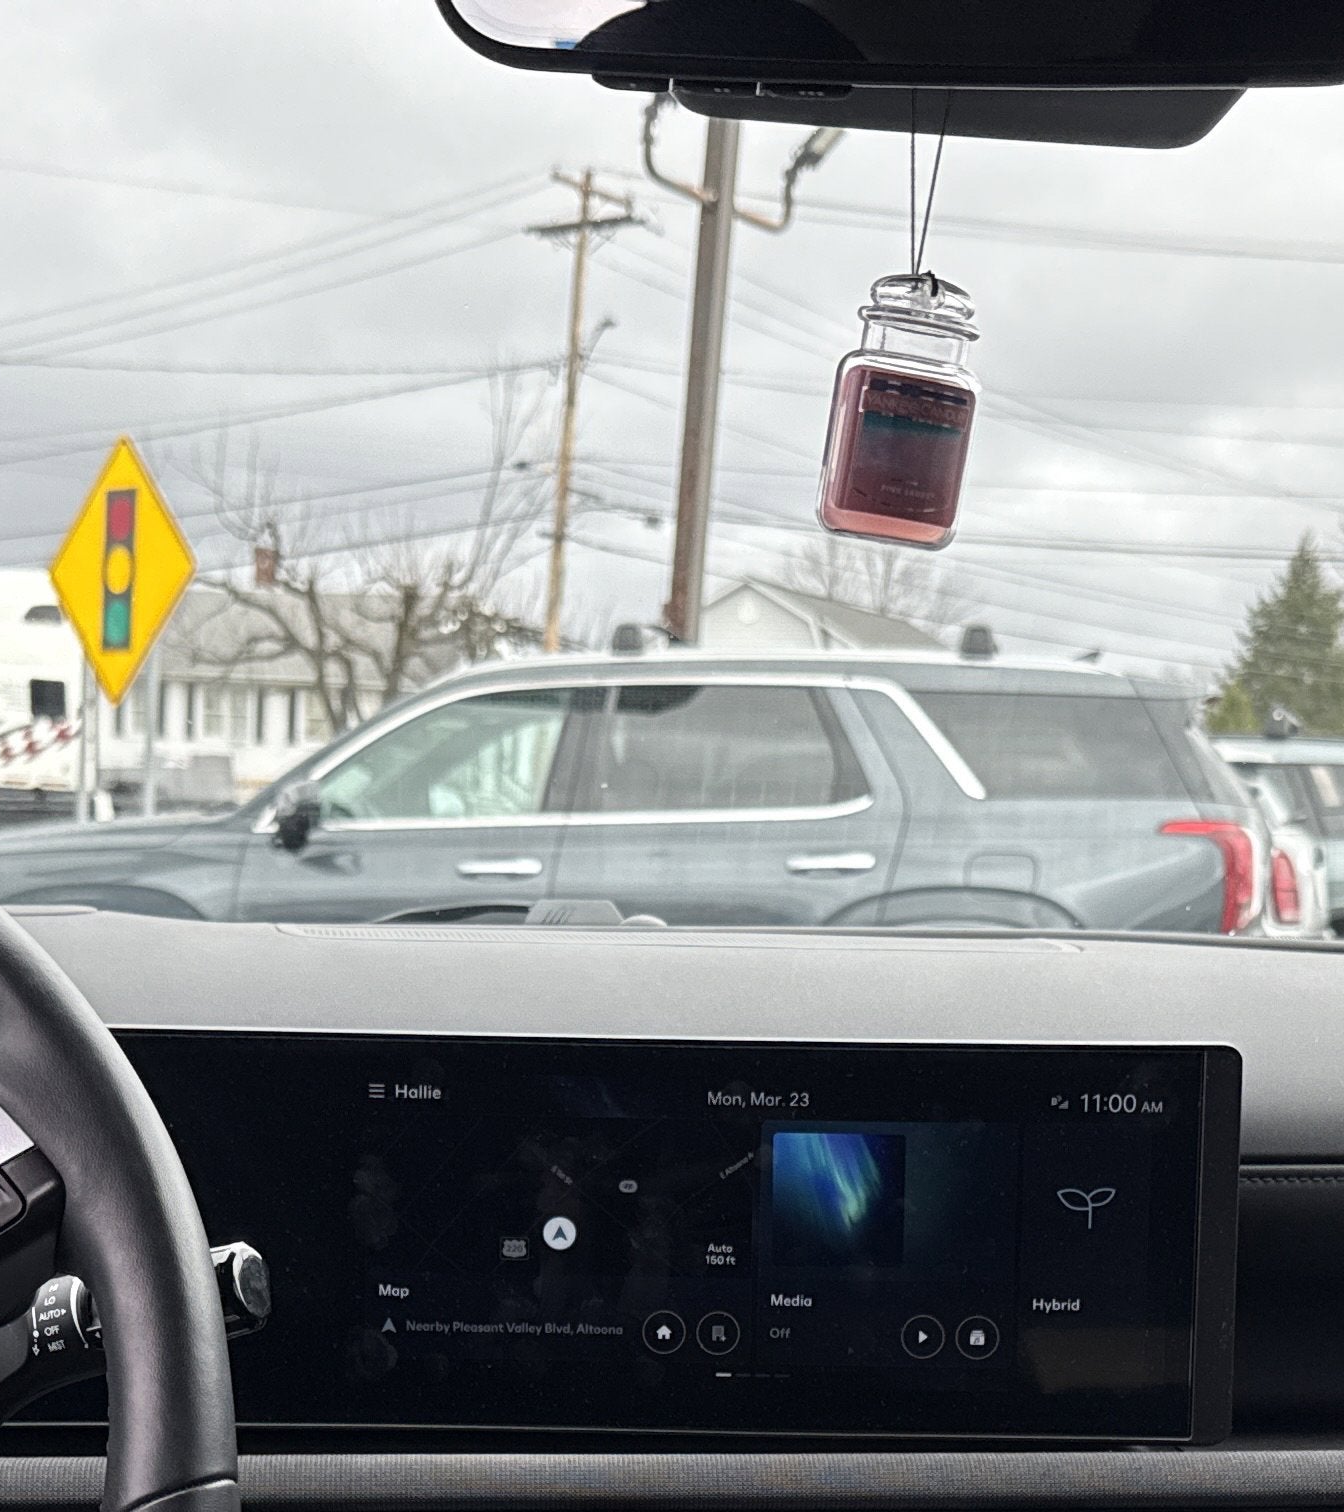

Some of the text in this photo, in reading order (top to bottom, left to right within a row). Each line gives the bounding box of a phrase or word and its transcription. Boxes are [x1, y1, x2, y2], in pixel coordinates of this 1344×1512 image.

[395, 1084, 442, 1100] Hallie
[707, 1092, 810, 1108] Mon, Mar. 23
[1080, 1094, 1163, 1113] 11:00 AM
[707, 1243, 733, 1254] Auto
[725, 1255, 736, 1266] ft
[378, 1284, 409, 1299] Map
[44, 1296, 56, 1306] LO
[770, 1294, 812, 1308] Media
[1032, 1298, 1080, 1314] Hybrid
[38, 1308, 61, 1322] AUTO
[44, 1325, 59, 1336] OFF
[406, 1320, 623, 1336] Nearby Pleasant Valley Blvd, Altoona
[769, 1327, 791, 1339] Off
